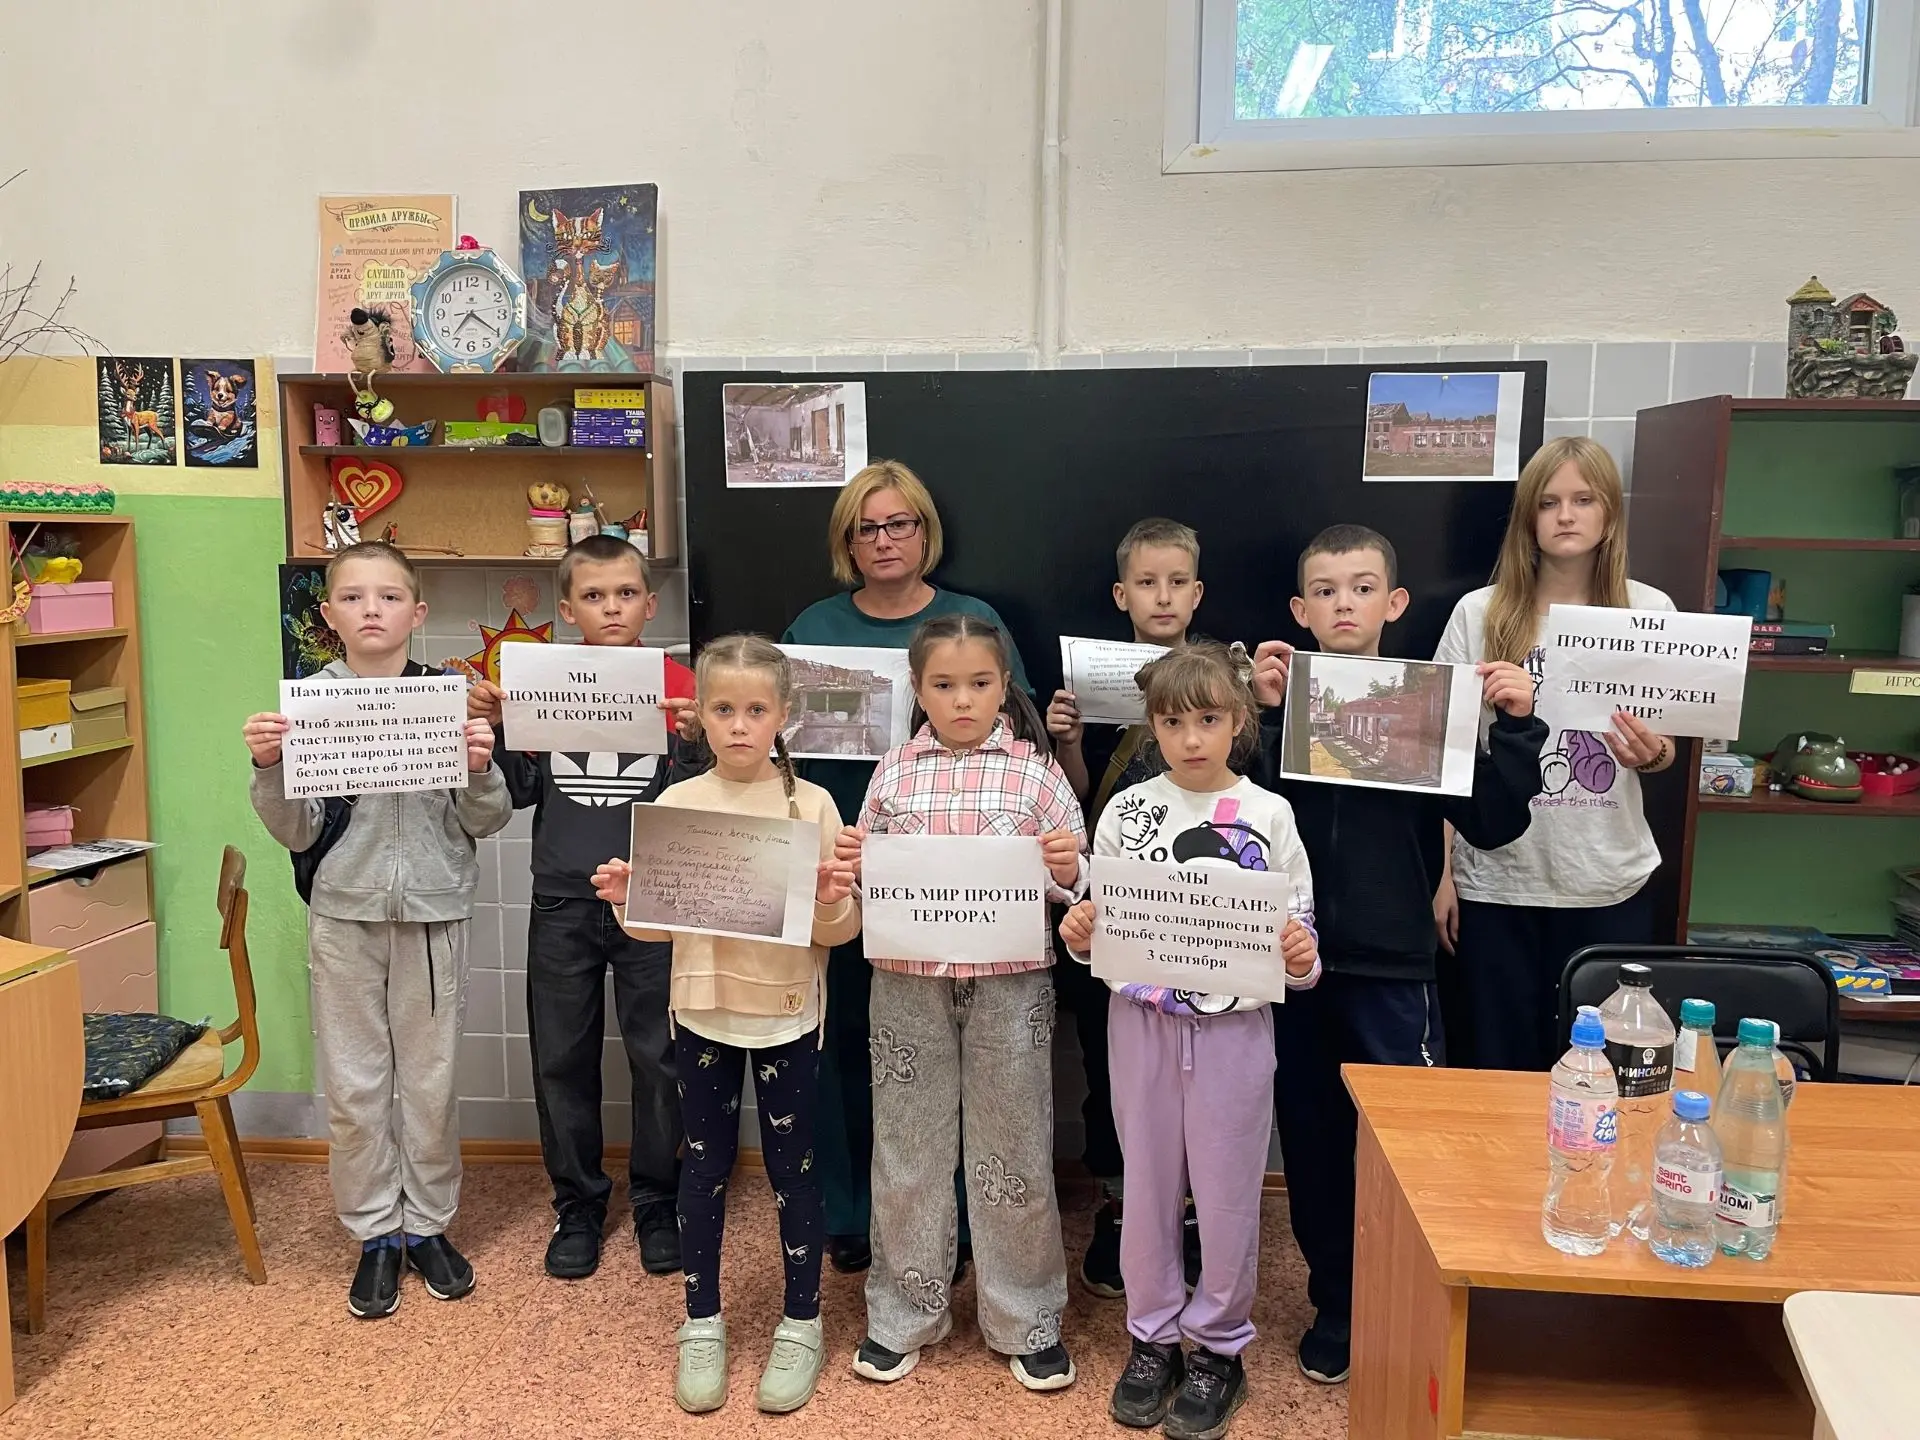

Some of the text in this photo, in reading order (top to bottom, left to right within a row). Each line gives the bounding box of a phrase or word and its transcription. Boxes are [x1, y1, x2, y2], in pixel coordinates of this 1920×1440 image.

[349, 210, 428, 229] ПРАВИЛА ДРУЖБЫ
[367, 269, 405, 279] СЛУШАТЬ
[374, 280, 405, 288] СЛЫШАТЬ
[452, 281, 462, 292] 11
[466, 276, 479, 288] 12
[485, 280, 490, 291] 1
[366, 291, 405, 300] ДРУГ ДРУГА
[441, 293, 451, 304] 10
[494, 292, 503, 303] 2
[436, 309, 445, 320] 9
[497, 309, 507, 320] 3
[441, 326, 450, 337] 8
[492, 327, 500, 338] 4
[452, 337, 461, 348] 7
[466, 341, 476, 352] 6
[482, 337, 491, 348] 5
[1630, 616, 1665, 631] МЫ
[1557, 634, 1738, 660] ПРОТИВ ТЕРРОРА!
[568, 672, 597, 684] МЫ
[290, 684, 458, 700] Нам нужно не много, не
[509, 690, 657, 705] ПОМНИМ БЕСЛАН
[1566, 679, 1716, 704] ДЕТЯМ НУЖЕН
[356, 700, 396, 711] мало:
[537, 709, 633, 721] И СКОРБИМ
[295, 715, 456, 729] Чтоб жизнь на планете
[290, 729, 462, 747] счастливую стала, пусть
[295, 746, 458, 764] дружат народы на всем
[296, 760, 459, 778] белом свете об этом вас
[293, 772, 463, 795] просят Бесланские дети!
[1168, 871, 1208, 885] «МЫ
[869, 887, 1039, 902] ВЕСЬ МИР ПРОТИВ
[1102, 884, 1278, 913] ПОМНИМ БЕСЛАН!»
[910, 909, 996, 923] ТЕРРОРА!
[1104, 905, 1274, 934] К дню солидарности в
[1106, 924, 1271, 953] борьбе с терроризмом
[1146, 949, 1228, 969] 3 сентября
[1618, 1065, 1667, 1078] МИНСКАЯ
